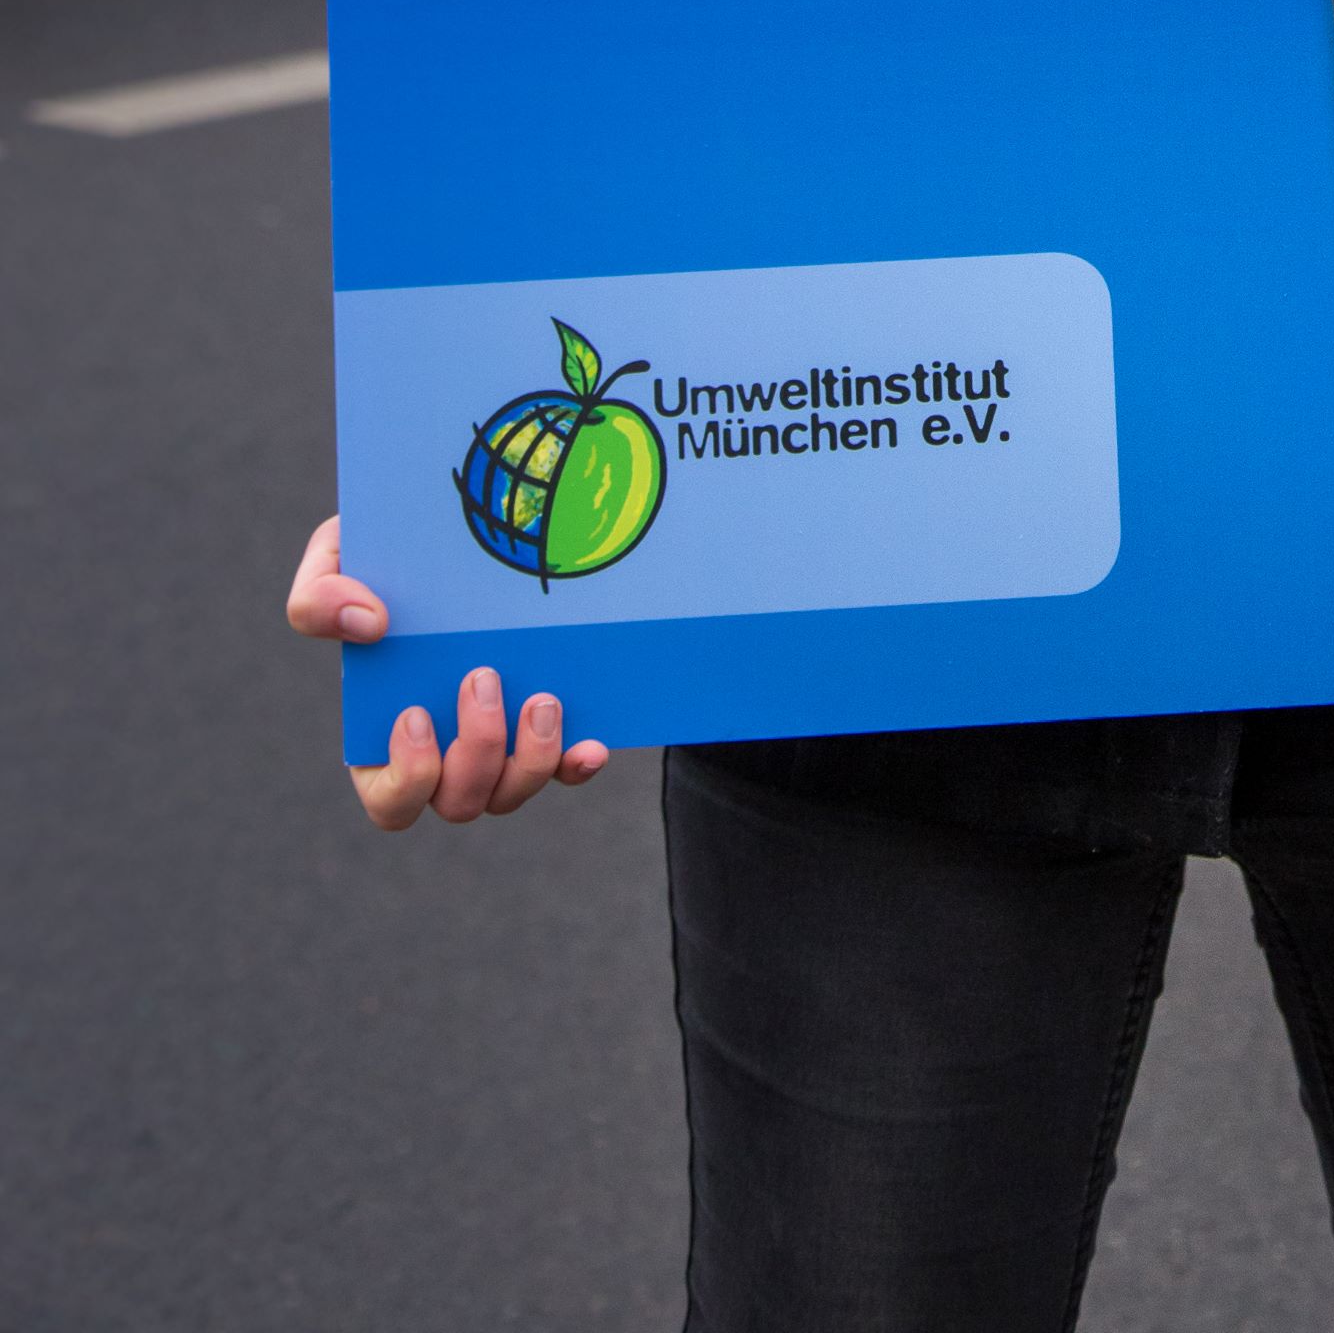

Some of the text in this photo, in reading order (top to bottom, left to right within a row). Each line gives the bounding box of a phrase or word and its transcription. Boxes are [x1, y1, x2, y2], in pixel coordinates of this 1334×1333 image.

[653, 359, 1010, 418] Umweltinstitut
[677, 403, 1010, 460] München e.V.
